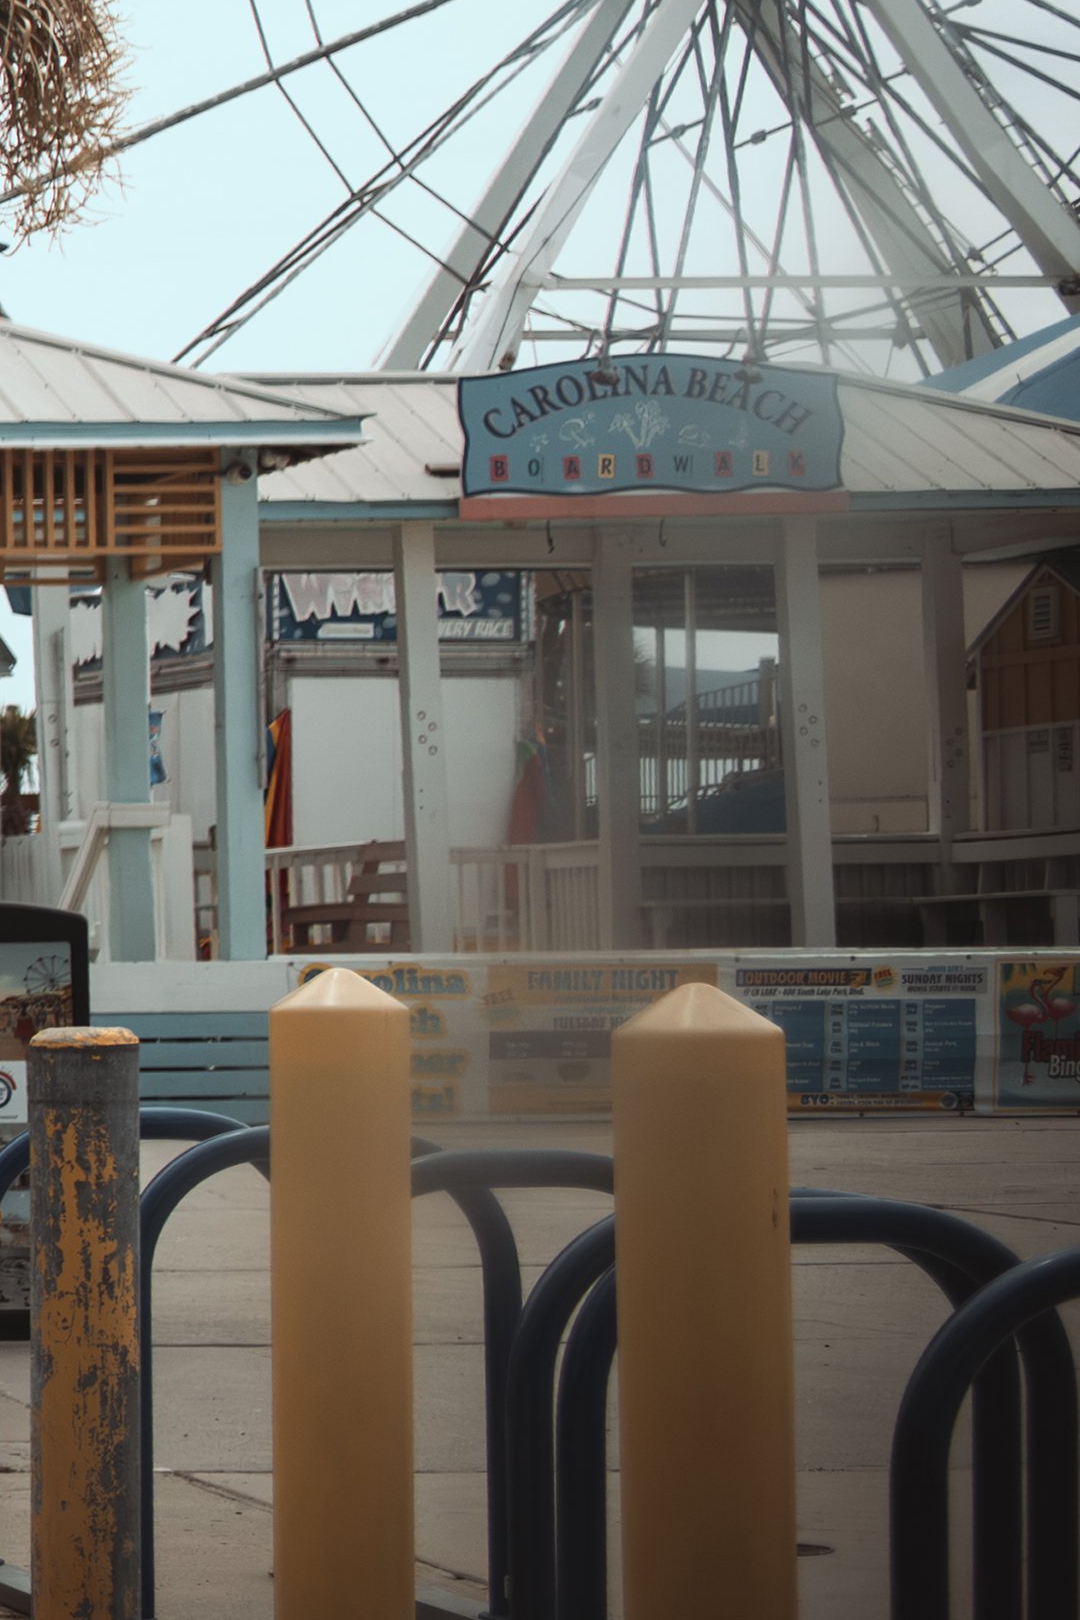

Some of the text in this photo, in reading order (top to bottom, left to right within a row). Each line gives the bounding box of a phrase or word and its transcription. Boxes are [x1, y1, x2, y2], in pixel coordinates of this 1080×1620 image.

[483, 365, 814, 439] CAROLINA BEACH
[494, 454, 805, 478] BOARDWALK
[437, 620, 472, 637] VERY
[527, 969, 680, 990] FAMILY NIGHT
[745, 972, 804, 984] OUTDOOR
[902, 973, 983, 984] SUNDAY NIGHTS
